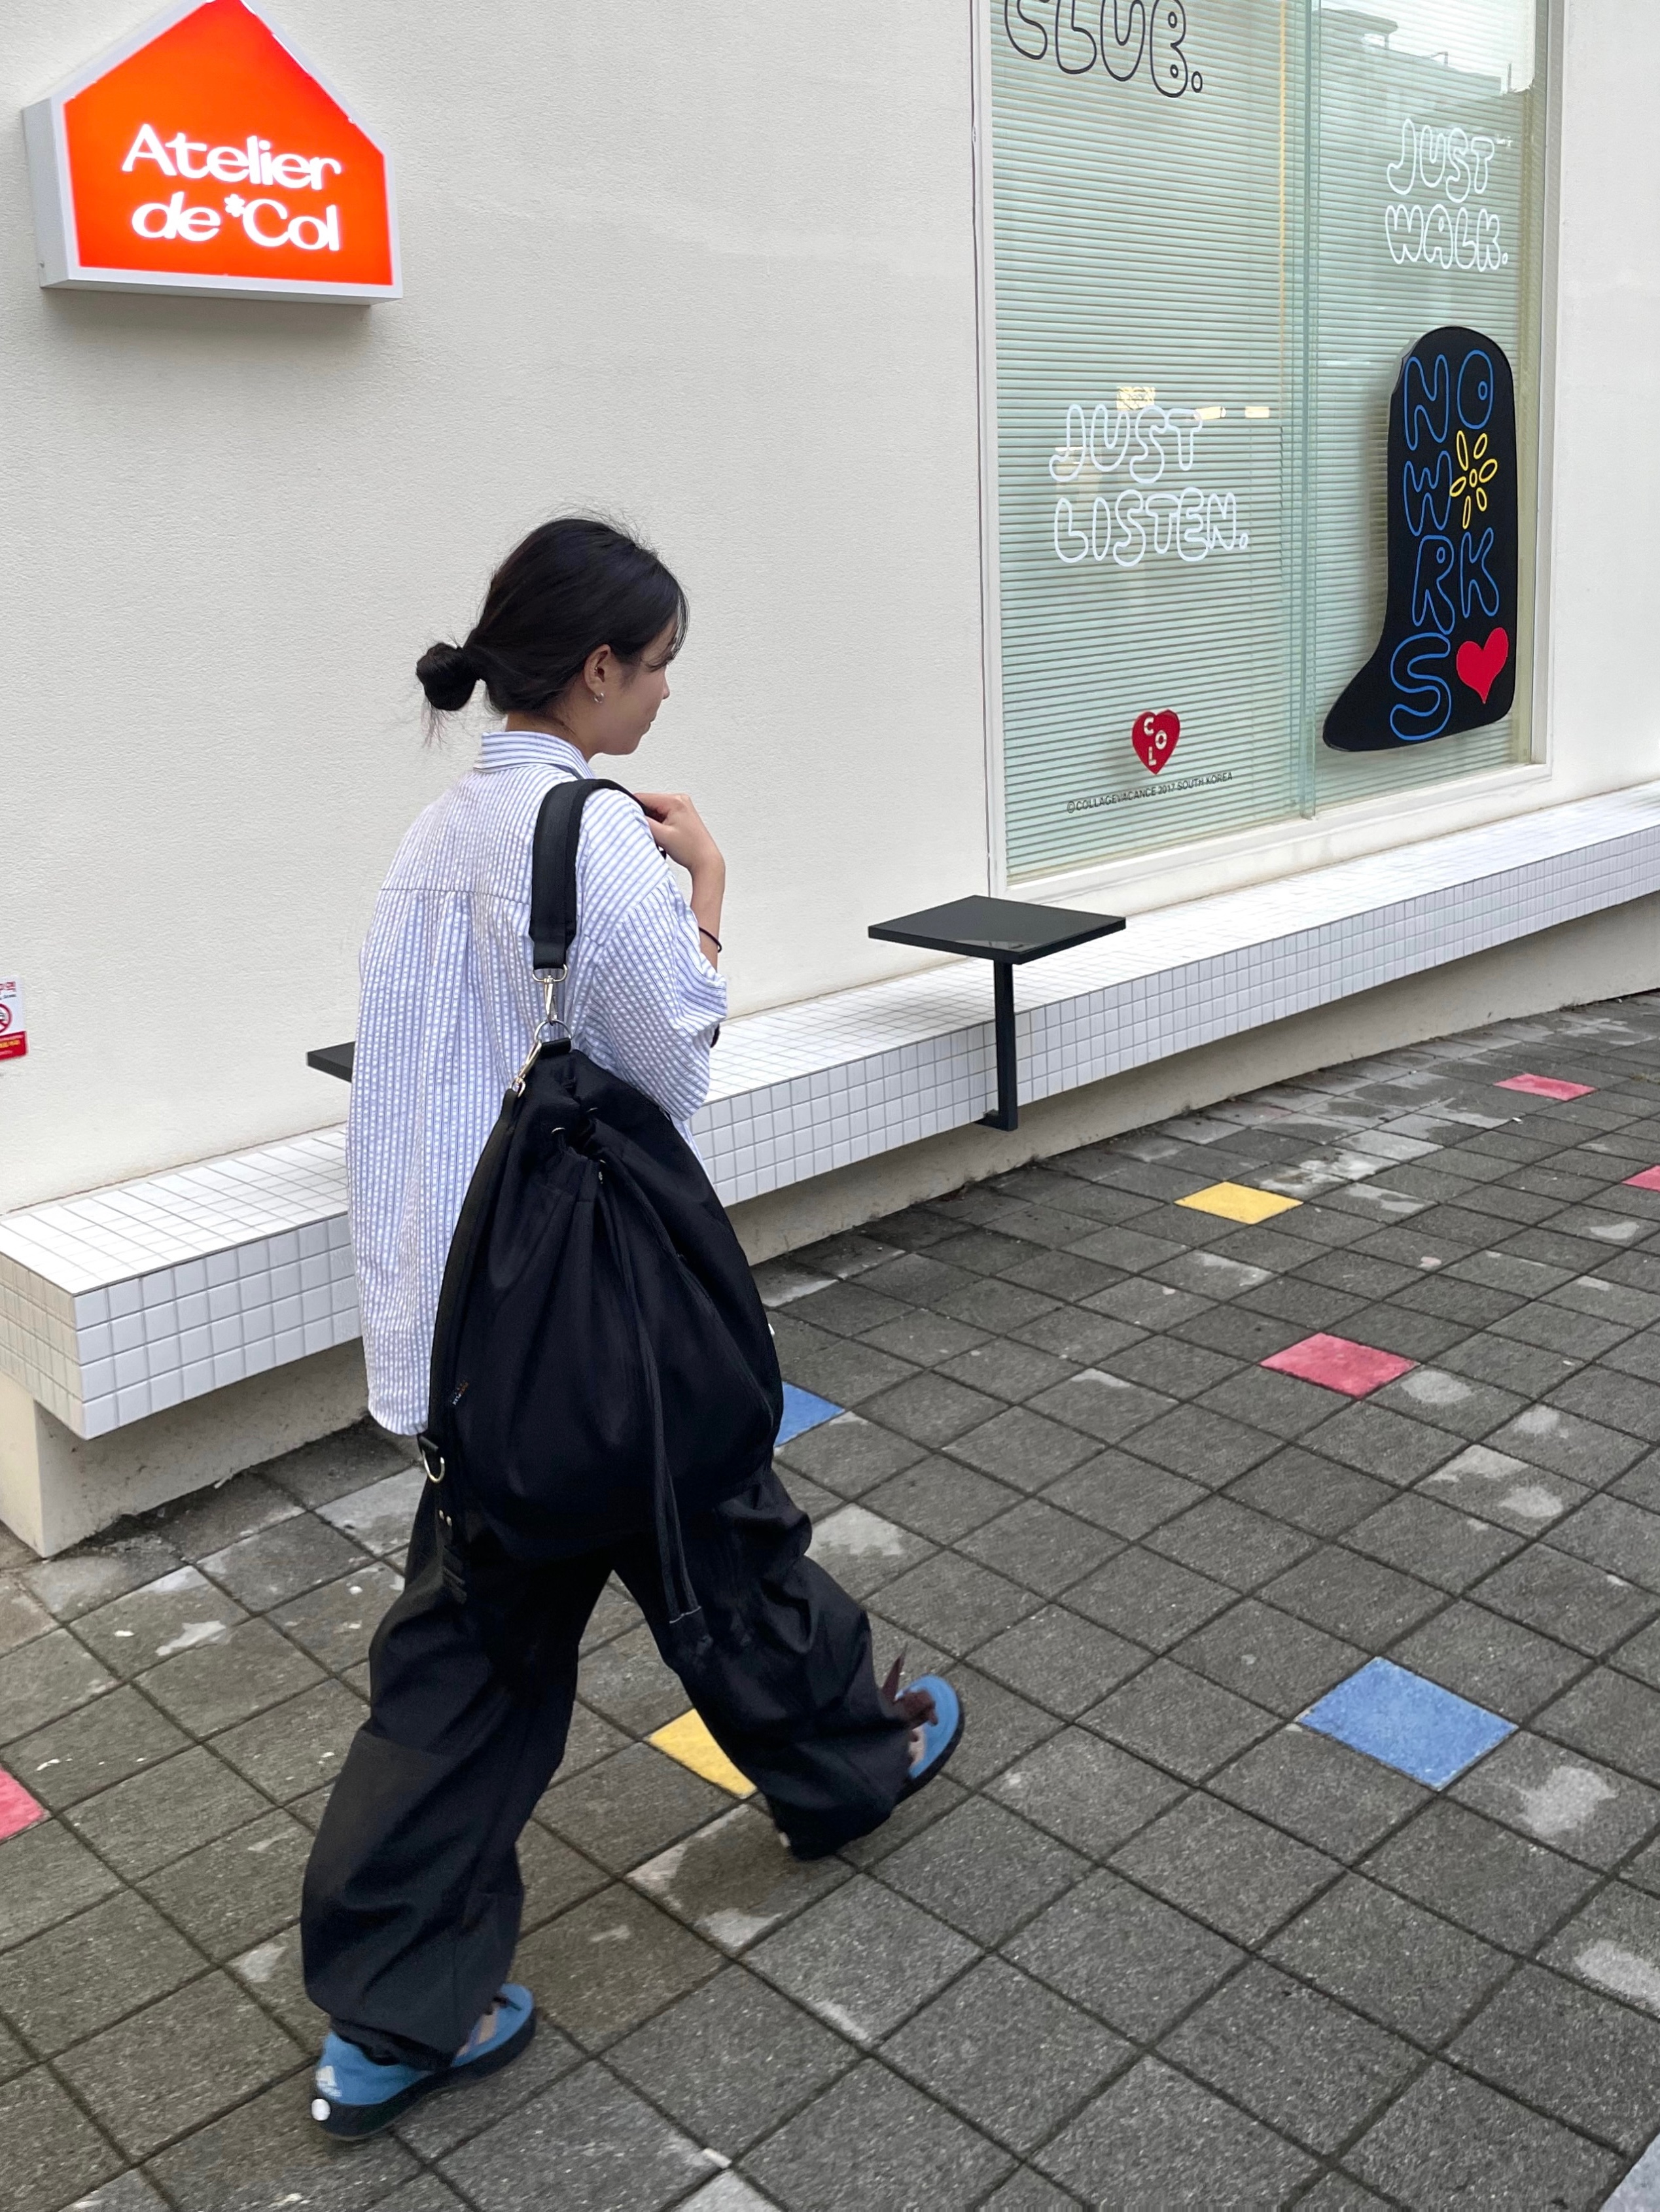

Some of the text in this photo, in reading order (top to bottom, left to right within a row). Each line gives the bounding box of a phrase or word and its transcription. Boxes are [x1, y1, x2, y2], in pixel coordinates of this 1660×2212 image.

[122, 124, 342, 190] Atelier
[1387, 118, 1495, 203] JUST
[1385, 203, 1508, 272] WALK.
[1404, 349, 1494, 450] NO
[1049, 404, 1203, 484] JUST
[1054, 487, 1248, 567] LISTEN.
[1157, 783, 1175, 794] 2017
[1177, 779, 1204, 790] SOUTH
[1206, 772, 1233, 784] KOREA
